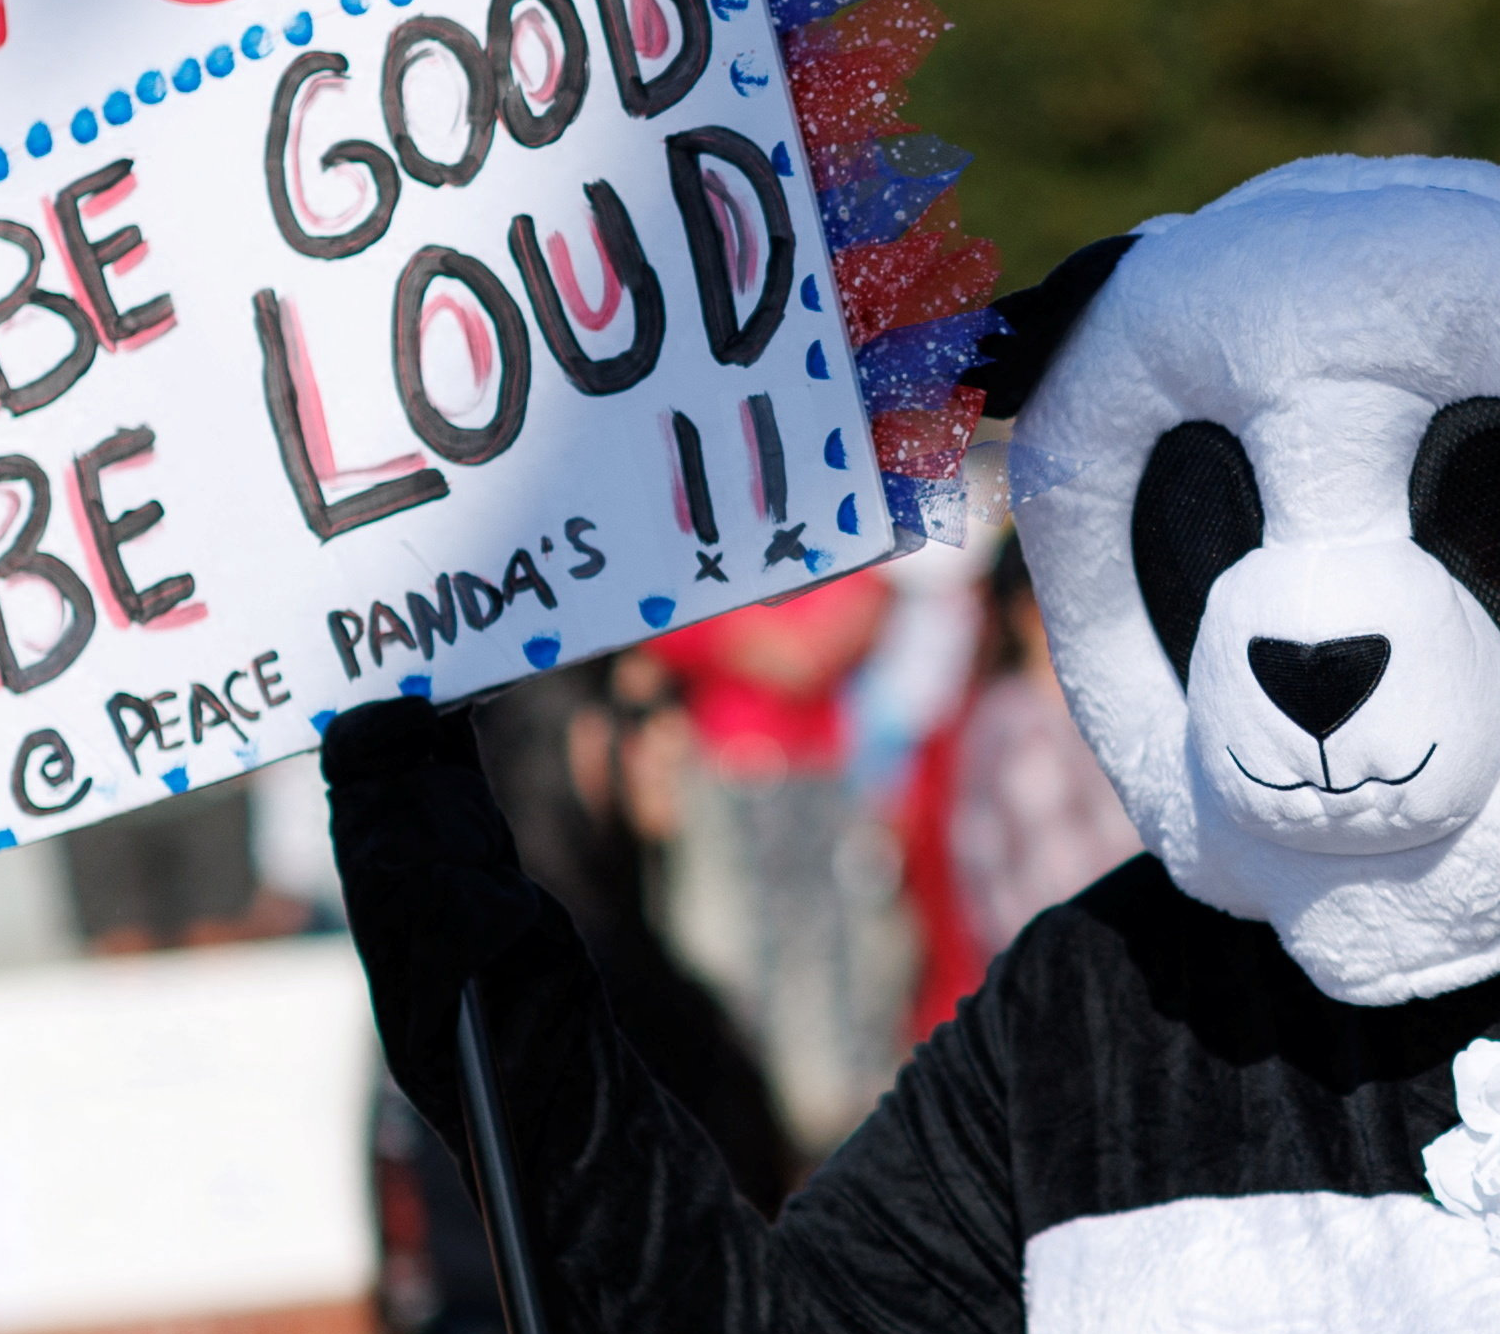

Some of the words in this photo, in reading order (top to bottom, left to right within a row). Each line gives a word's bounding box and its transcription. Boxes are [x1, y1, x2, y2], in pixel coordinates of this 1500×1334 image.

[252, 124, 797, 544] LOUD
[9, 728, 93, 816] @
[105, 650, 292, 777] PEACE
[327, 516, 608, 681] PANDA'S
